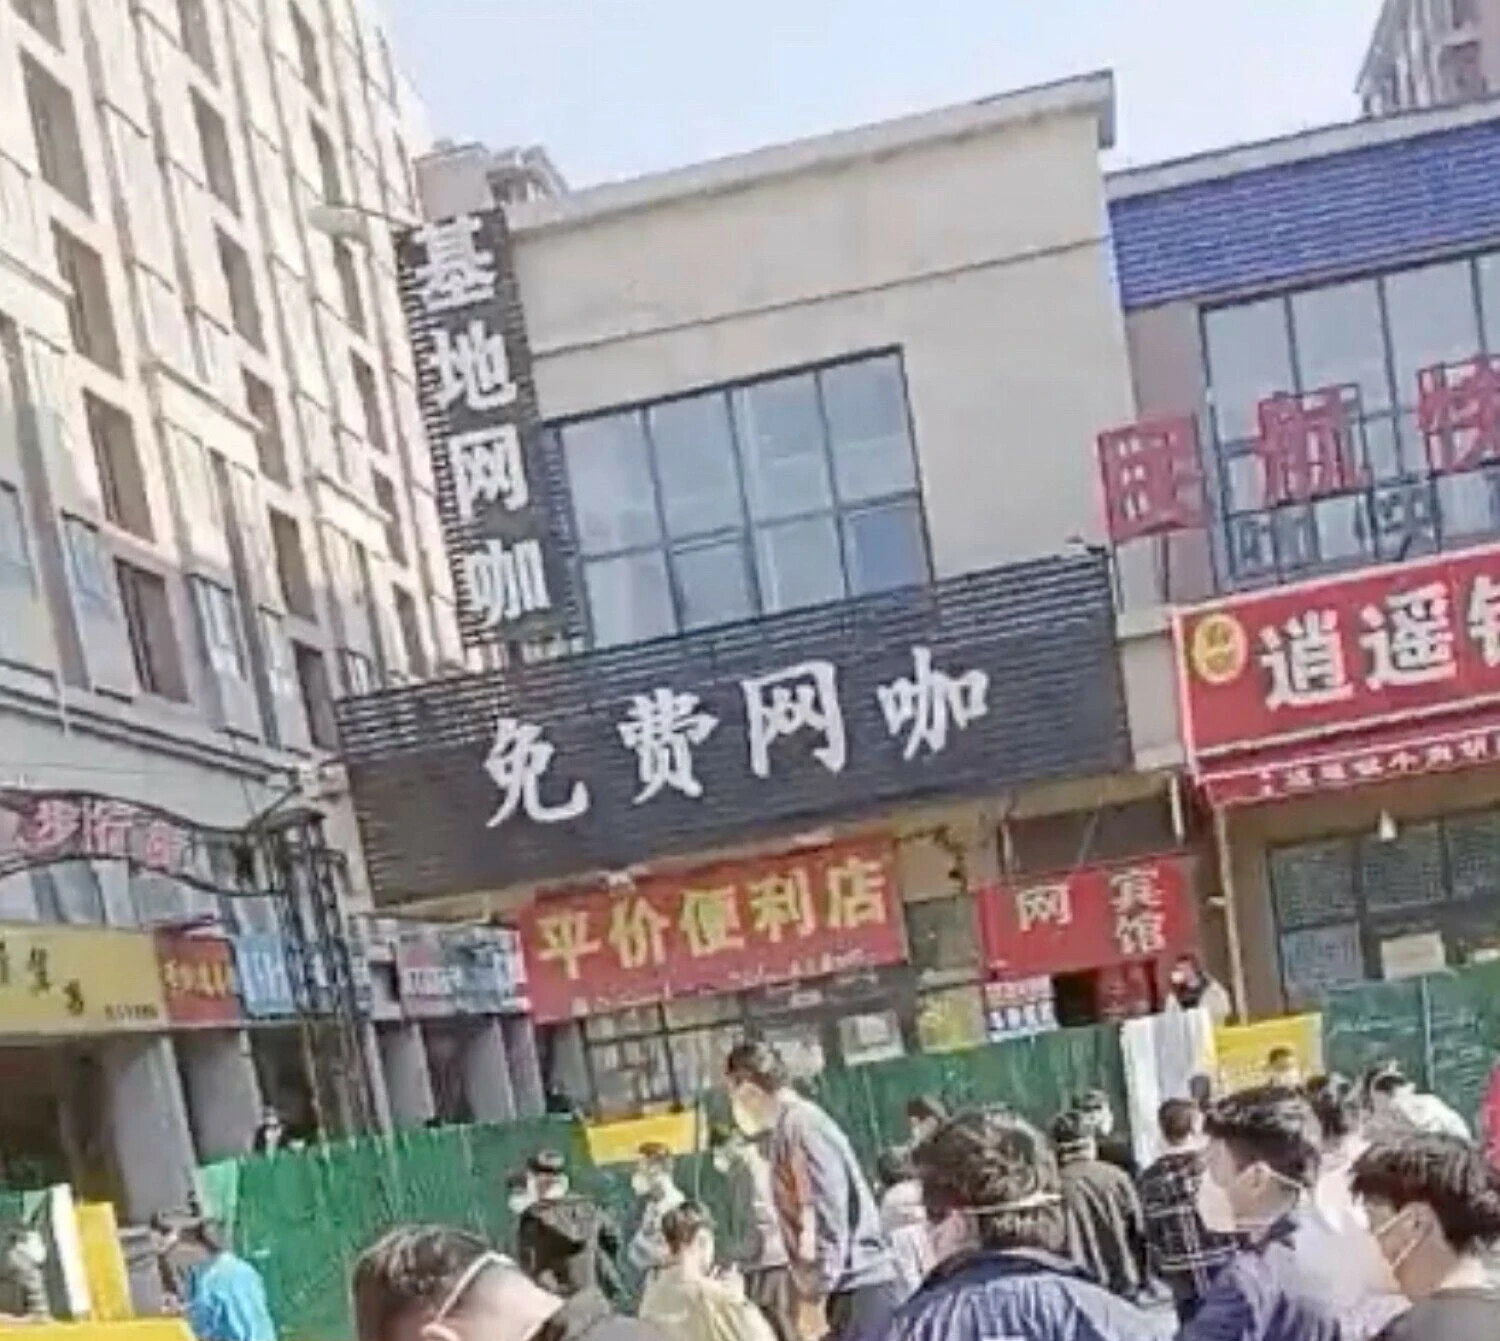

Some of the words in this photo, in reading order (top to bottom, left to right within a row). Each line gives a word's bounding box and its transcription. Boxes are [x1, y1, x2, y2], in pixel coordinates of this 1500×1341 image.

[411, 214, 550, 623] 基地网咖
[485, 646, 990, 828] 免费网咖
[535, 854, 887, 981] 平价便利店
[1015, 883, 1073, 932] 网
